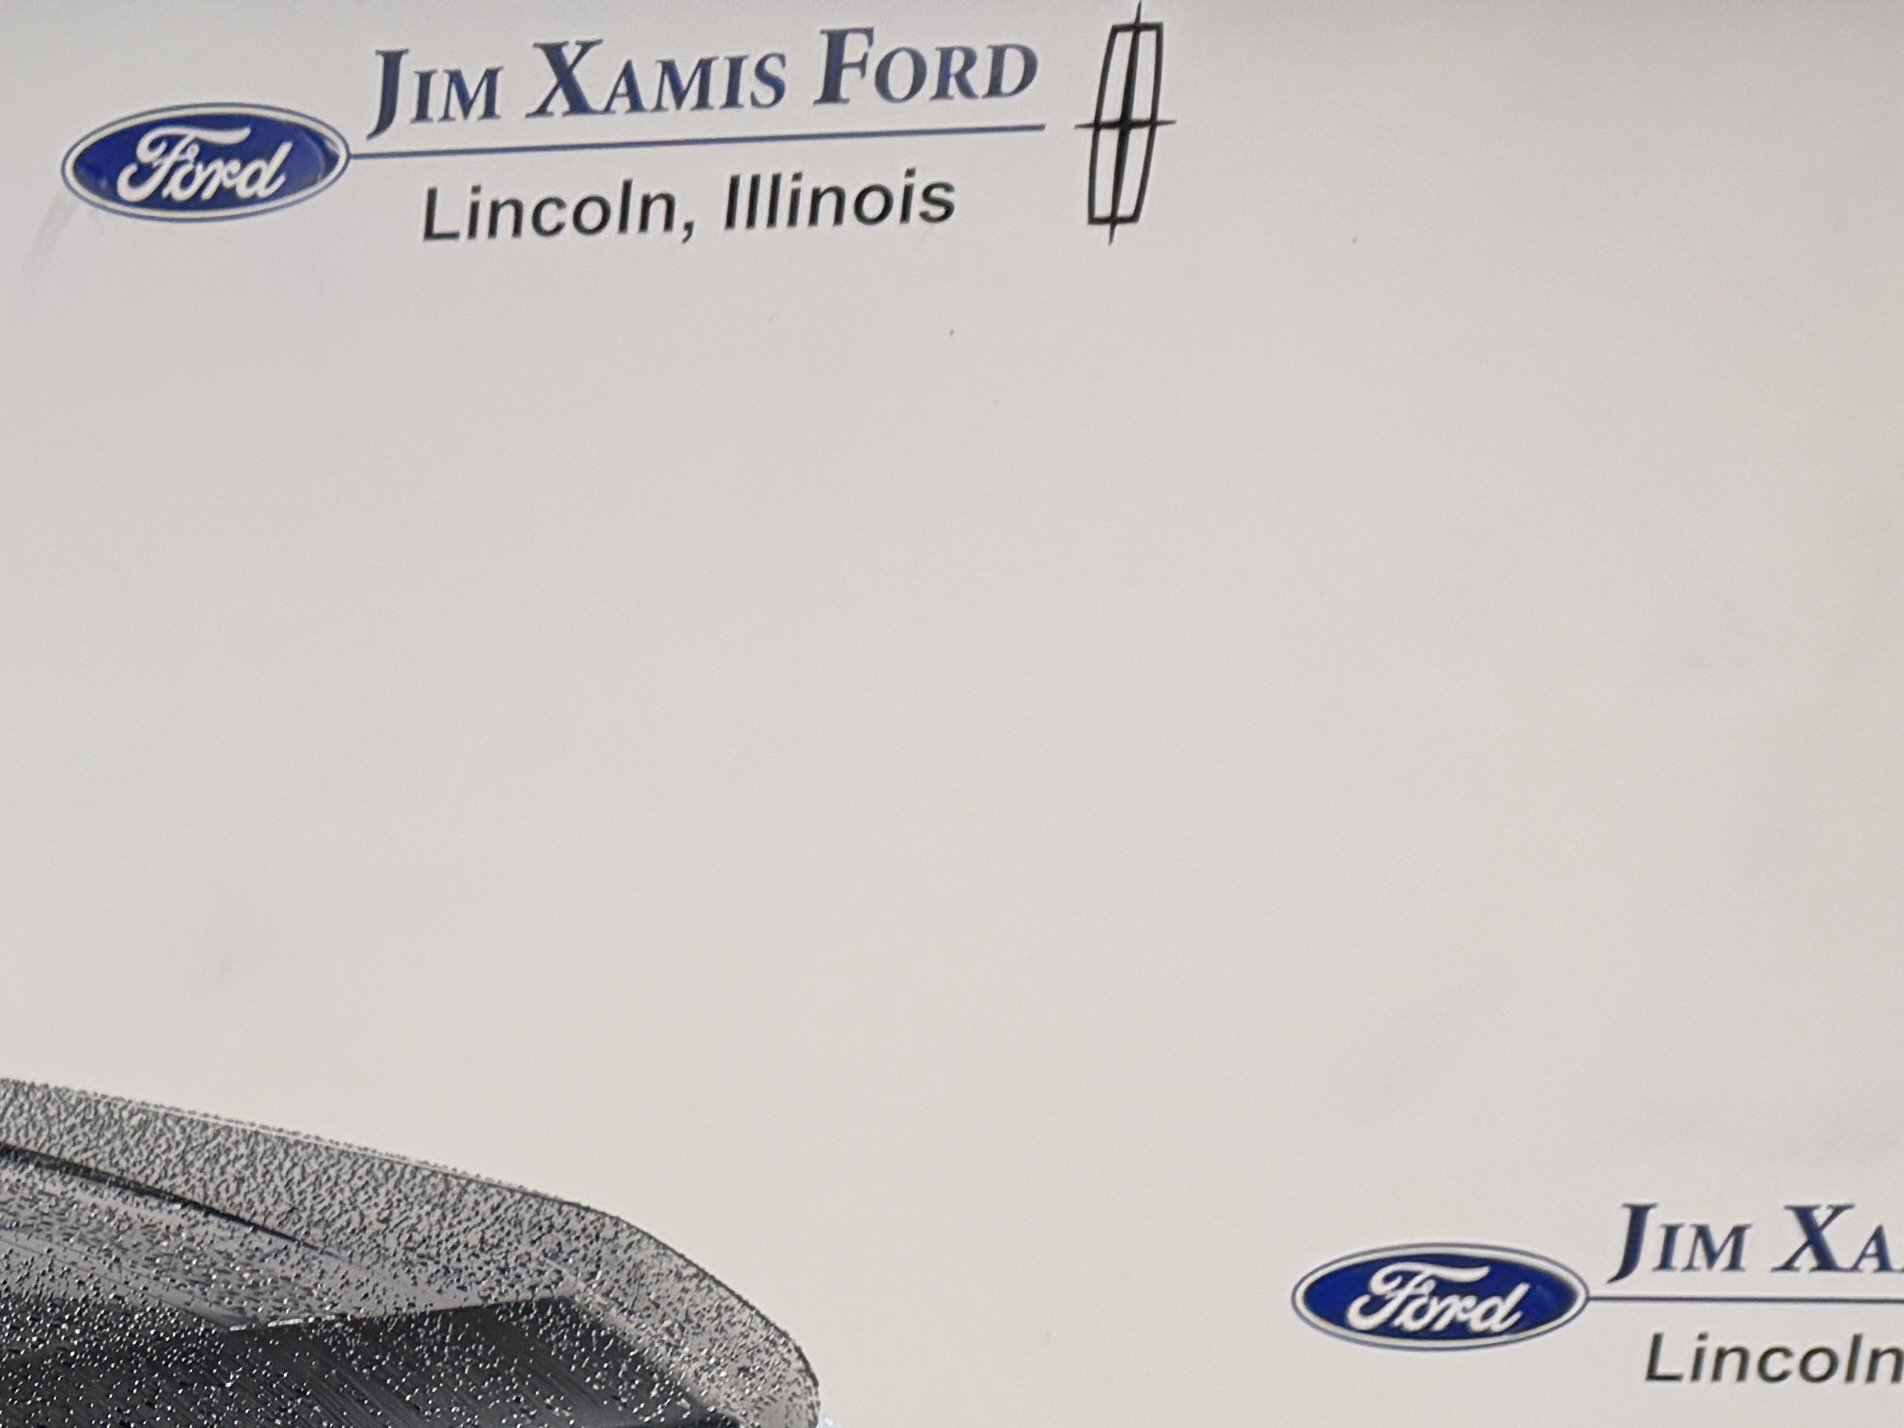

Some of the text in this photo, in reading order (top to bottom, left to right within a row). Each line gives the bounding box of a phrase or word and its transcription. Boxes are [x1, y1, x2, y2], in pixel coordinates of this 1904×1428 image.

[365, 26, 1039, 140] JIM XAMIS FORD
[116, 126, 293, 202] Ford
[423, 167, 956, 244] Lincoln, Illinois
[1606, 1202, 1753, 1284] JIM
[1346, 1260, 1532, 1333] Ford
[1645, 1331, 1904, 1384] Lincoln
